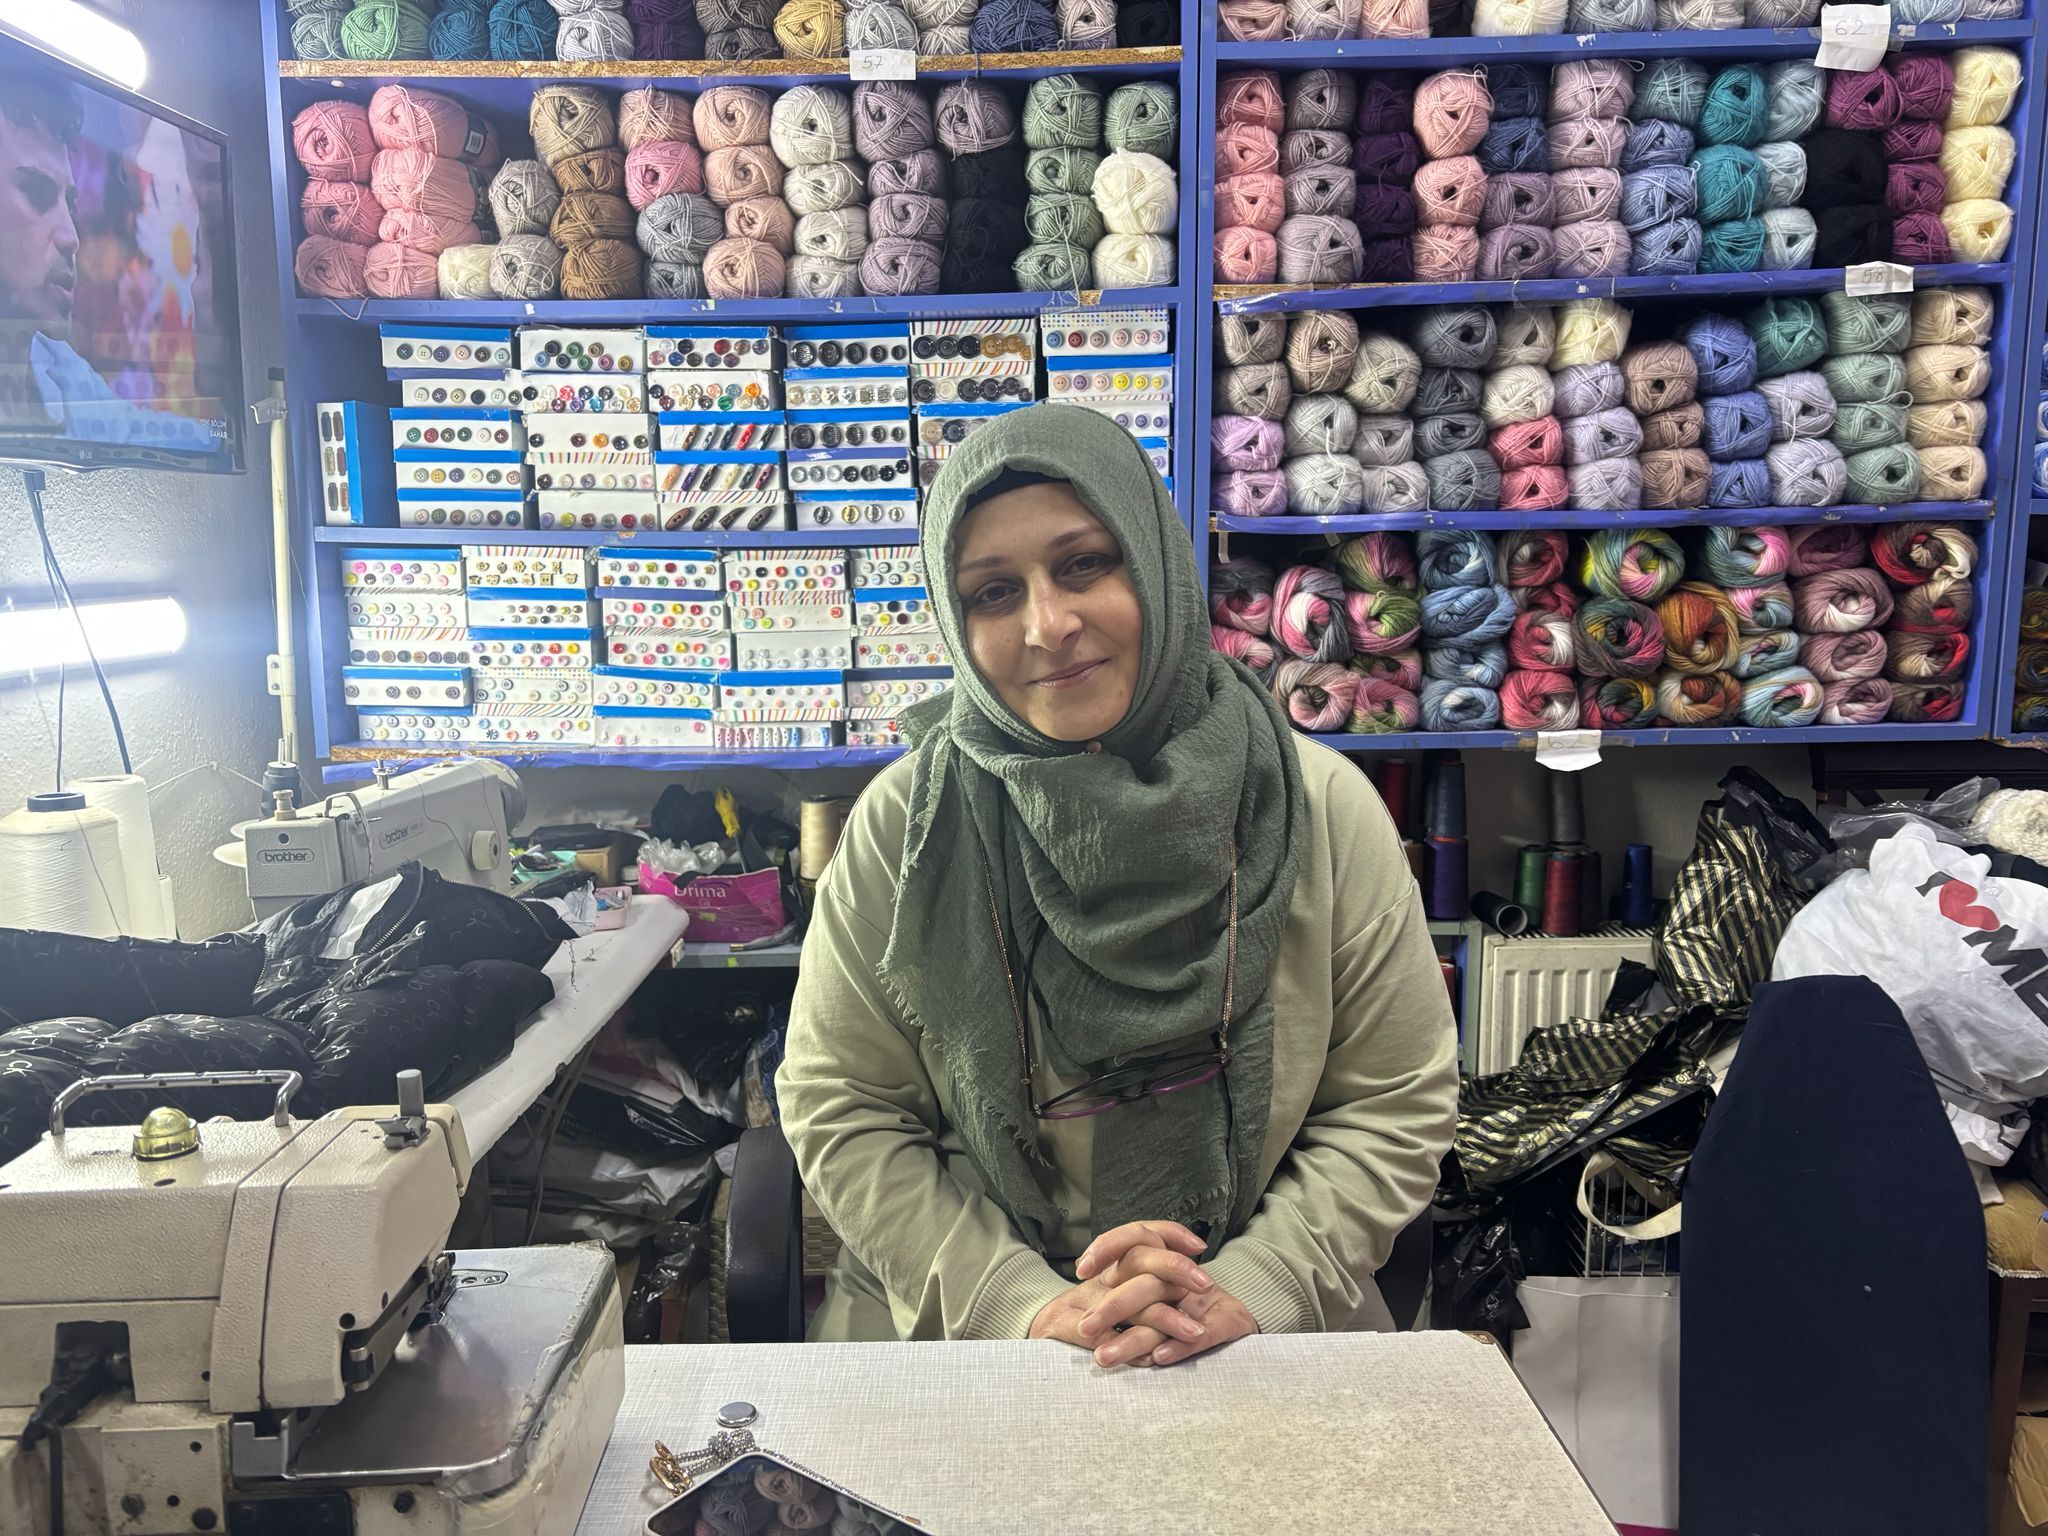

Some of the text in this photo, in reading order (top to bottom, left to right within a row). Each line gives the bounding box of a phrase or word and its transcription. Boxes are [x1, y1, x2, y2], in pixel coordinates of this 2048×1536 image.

[1835, 19, 1867, 36] 62
[862, 55, 884, 70] 57
[265, 851, 308, 863] brother
